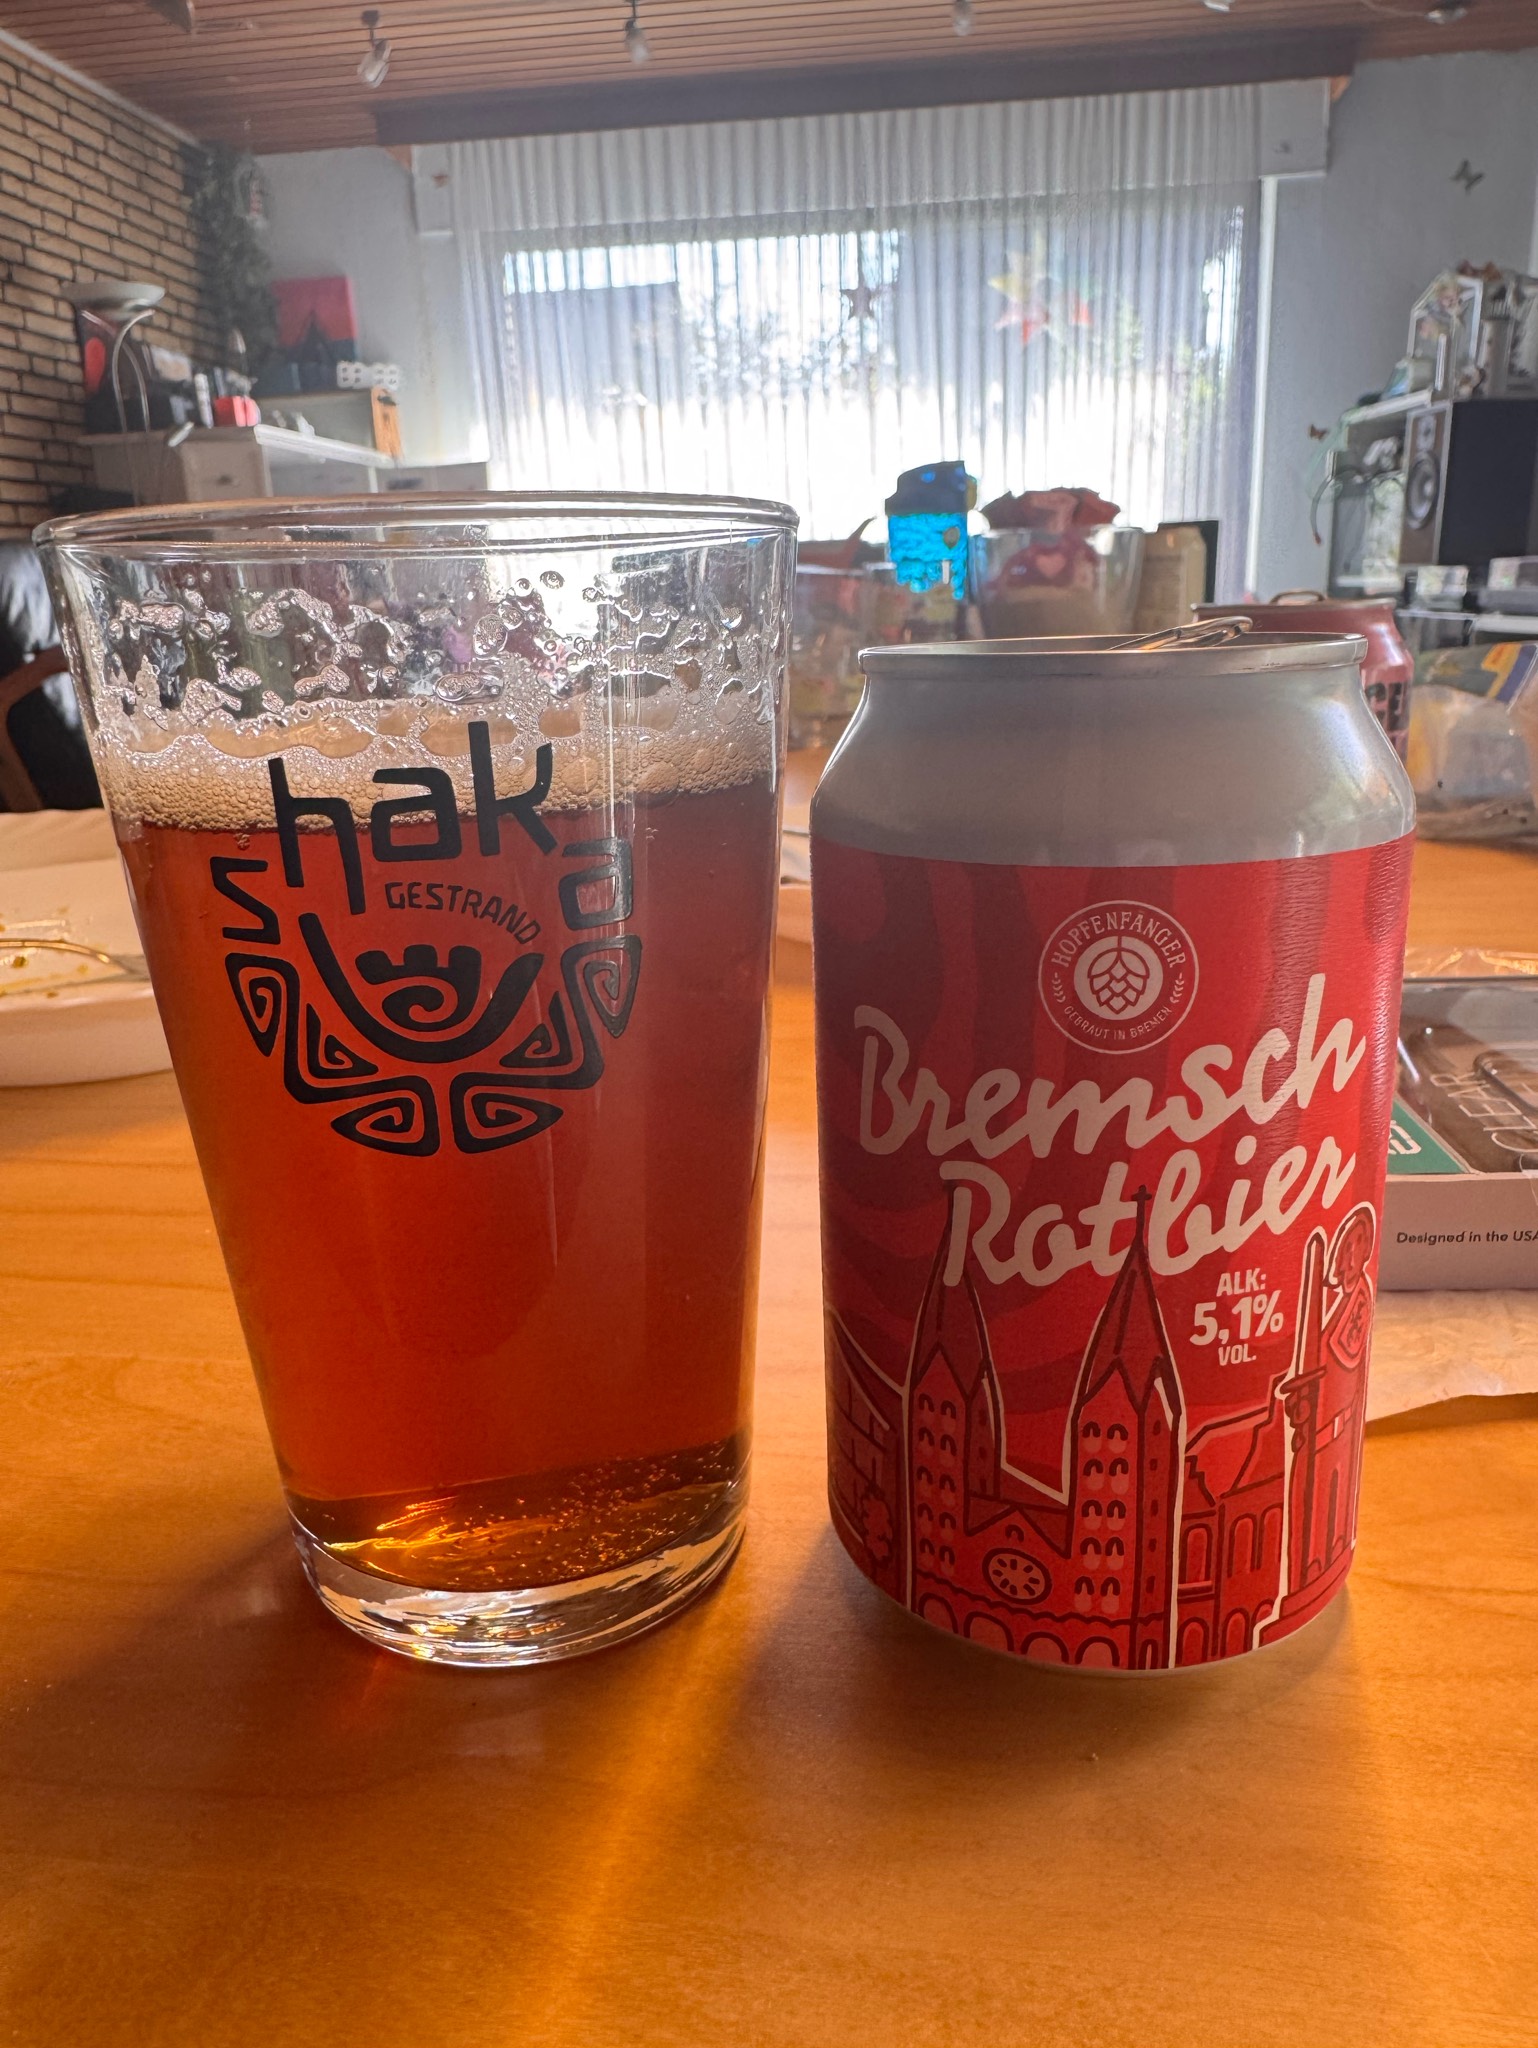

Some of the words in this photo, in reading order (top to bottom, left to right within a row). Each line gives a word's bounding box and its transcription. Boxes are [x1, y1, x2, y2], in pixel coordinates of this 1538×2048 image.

[384, 881, 542, 945] GESTRAND
[1064, 1005, 1110, 1039] GEBRAUT
[1113, 1029, 1126, 1040] IN
[1129, 1006, 1173, 1039] BREMEN
[854, 973, 1366, 1158] Bremsch
[939, 1136, 1356, 1287] Rotbier
[1396, 1231, 1466, 1246] Designed
[1468, 1231, 1482, 1242] in
[1486, 1230, 1508, 1242] the
[1216, 1267, 1267, 1297] ALK:
[1189, 1289, 1284, 1346] 5,1%
[1218, 1343, 1257, 1366] VOL.
